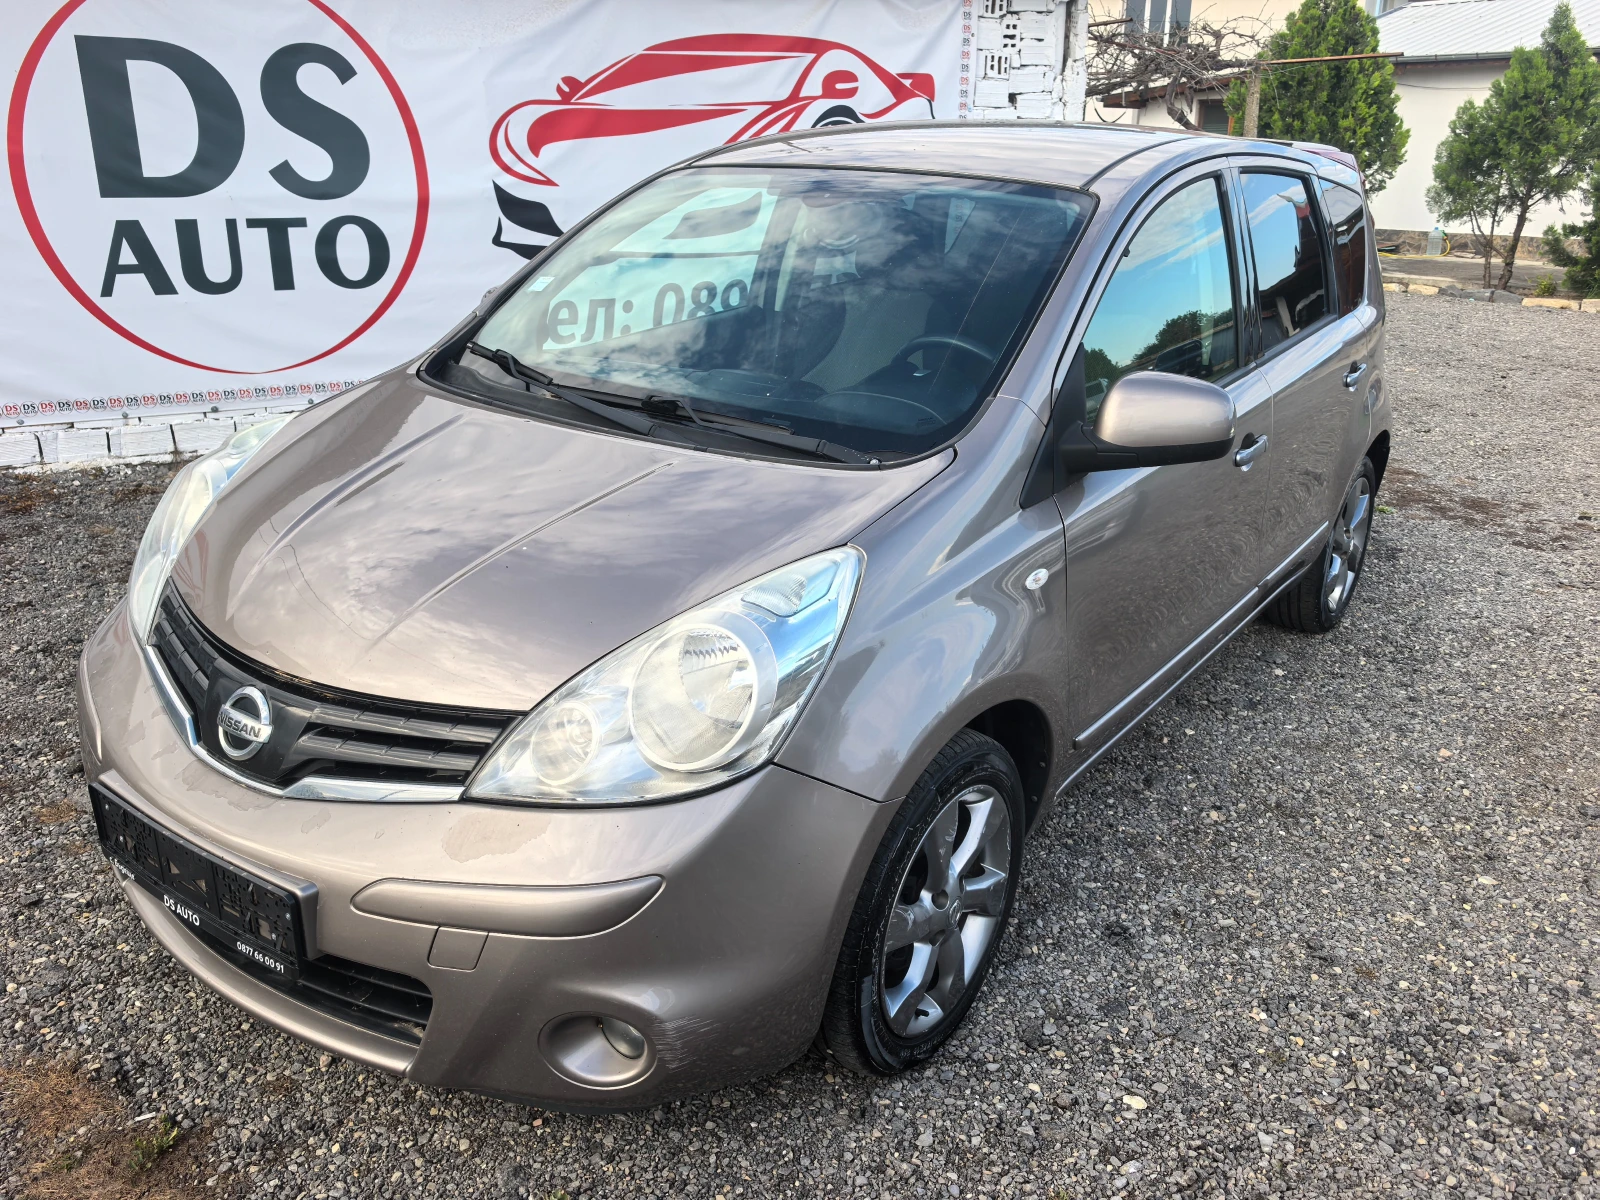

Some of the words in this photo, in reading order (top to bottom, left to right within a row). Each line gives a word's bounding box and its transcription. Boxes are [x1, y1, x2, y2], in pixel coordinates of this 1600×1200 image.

[74, 35, 370, 200] DS
[100, 215, 390, 297] AUTO
[548, 299, 633, 344] ел:
[220, 712, 261, 738] NISSAN
[164, 894, 175, 911] DS
[177, 904, 200, 926] AUTO
[236, 942, 253, 956] 0877
[254, 951, 263, 962] 66
[265, 956, 274, 967] 00
[276, 963, 284, 973] 91
